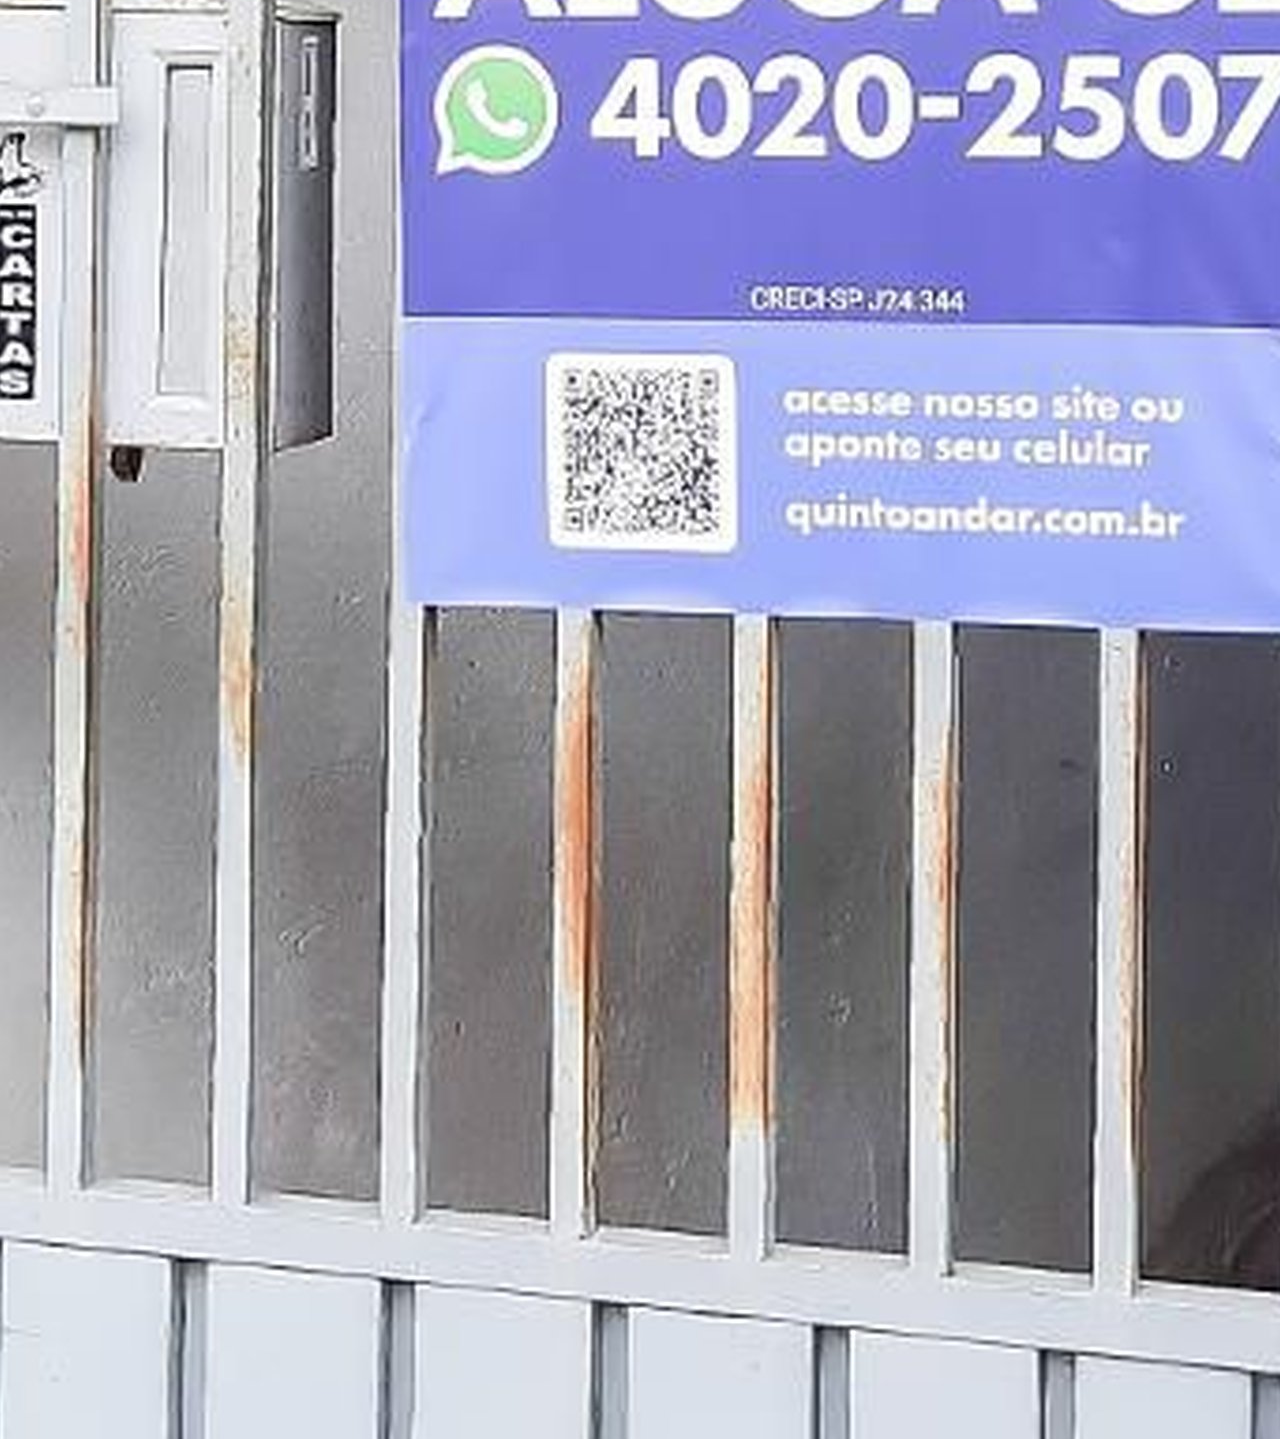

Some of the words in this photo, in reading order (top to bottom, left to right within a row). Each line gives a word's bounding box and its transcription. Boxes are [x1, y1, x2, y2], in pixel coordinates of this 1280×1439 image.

[750, 285, 864, 312] CRECI-SP
[782, 388, 913, 417] acesse
[923, 392, 1040, 420] nosso
[1051, 385, 1121, 422] site
[1130, 396, 1184, 423] ou
[784, 430, 923, 469] aponte
[934, 435, 1002, 463] seu
[1012, 428, 1152, 468] celular
[785, 491, 1187, 538] quintoandar.com.br
